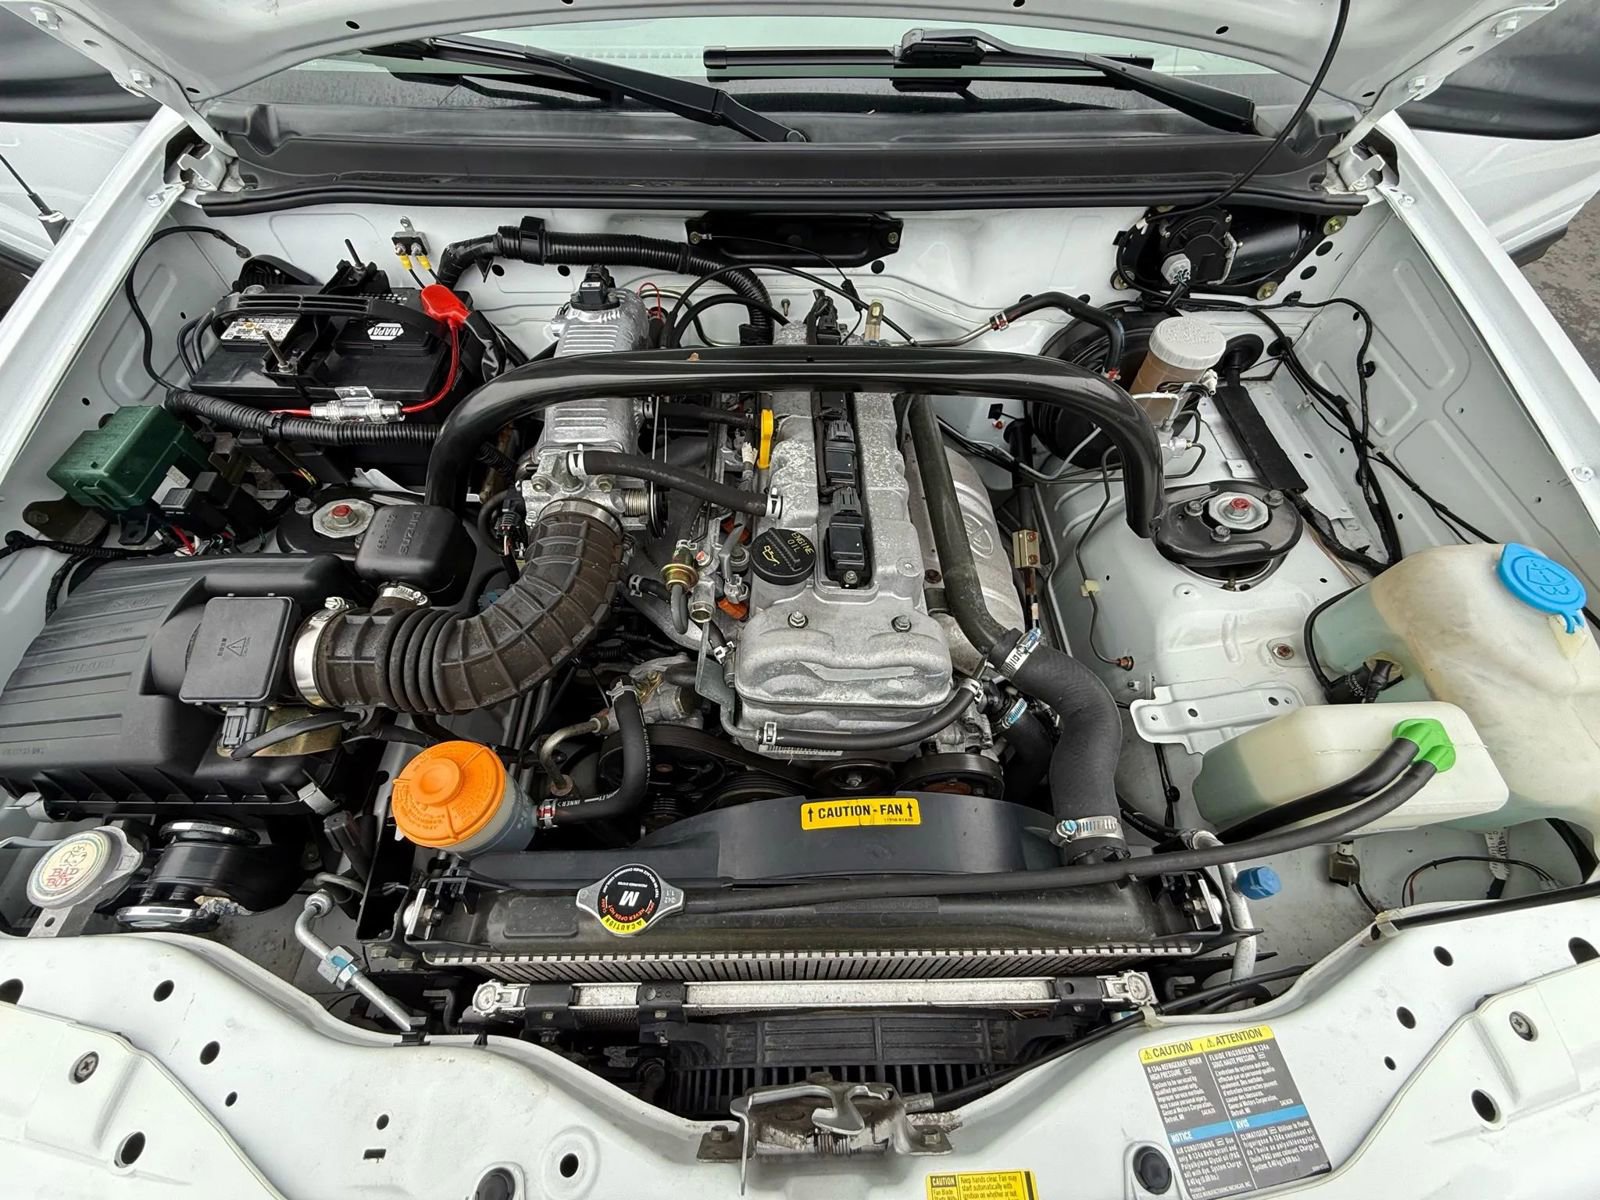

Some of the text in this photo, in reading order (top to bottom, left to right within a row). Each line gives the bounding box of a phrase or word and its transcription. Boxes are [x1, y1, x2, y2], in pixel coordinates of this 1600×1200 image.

[373, 326, 401, 336] NAPA
[787, 539, 801, 553] OIL
[791, 531, 815, 555] ENGINE
[818, 804, 871, 819] CAUTION
[880, 804, 903, 815] FAN
[616, 913, 628, 922] OPEN
[1215, 1028, 1263, 1046] ATTENTION
[1152, 1041, 1193, 1058] CAUTION
[1235, 1119, 1250, 1129] AVIS
[1171, 1131, 1193, 1143] NOTICE
